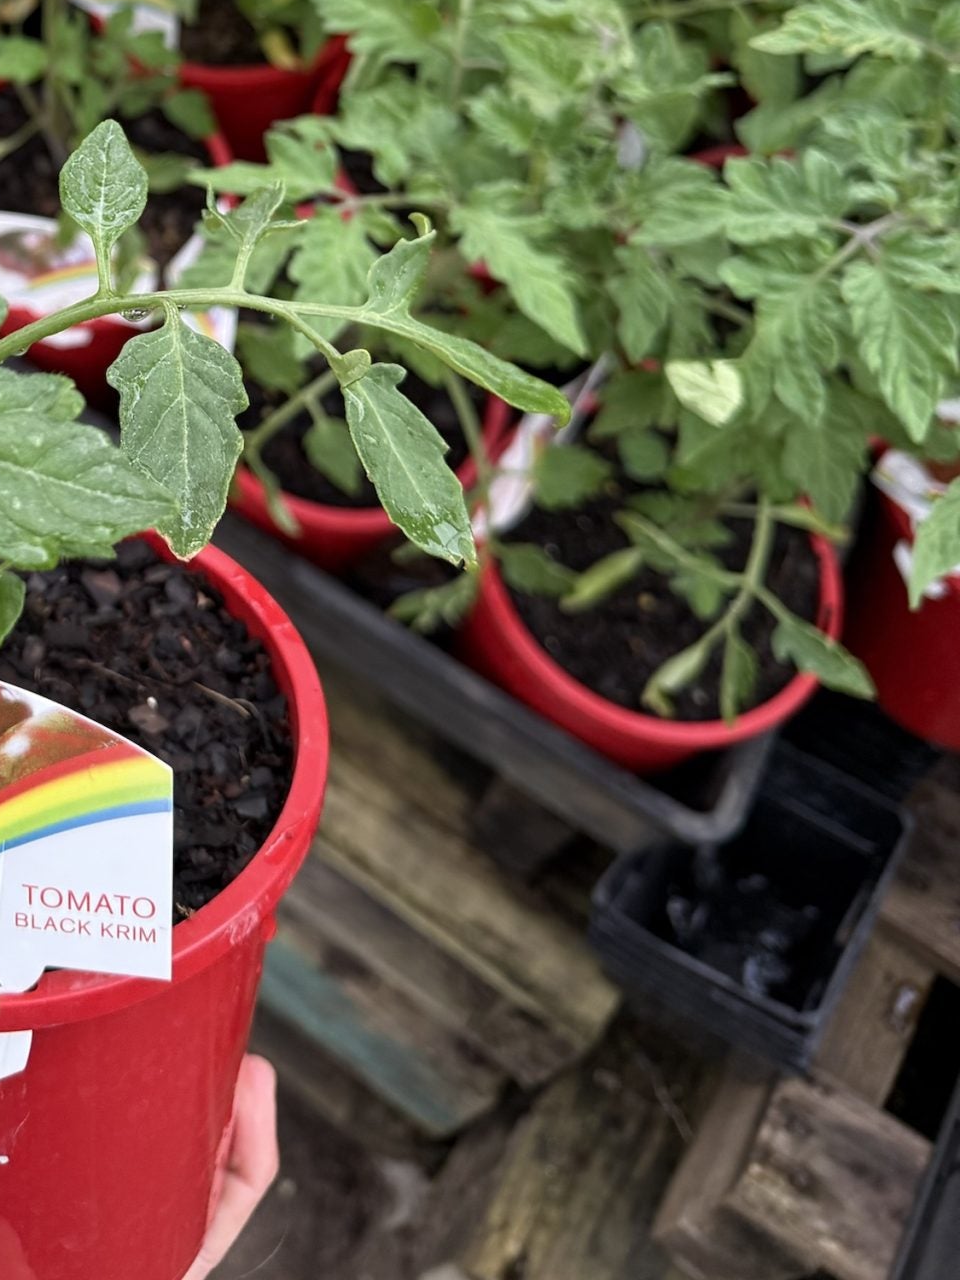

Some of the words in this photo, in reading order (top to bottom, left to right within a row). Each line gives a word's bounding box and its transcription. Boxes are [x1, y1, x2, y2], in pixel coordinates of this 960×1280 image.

[22, 883, 156, 919] TOMATO
[14, 911, 91, 936] BLACK
[100, 922, 156, 943] KRIM
